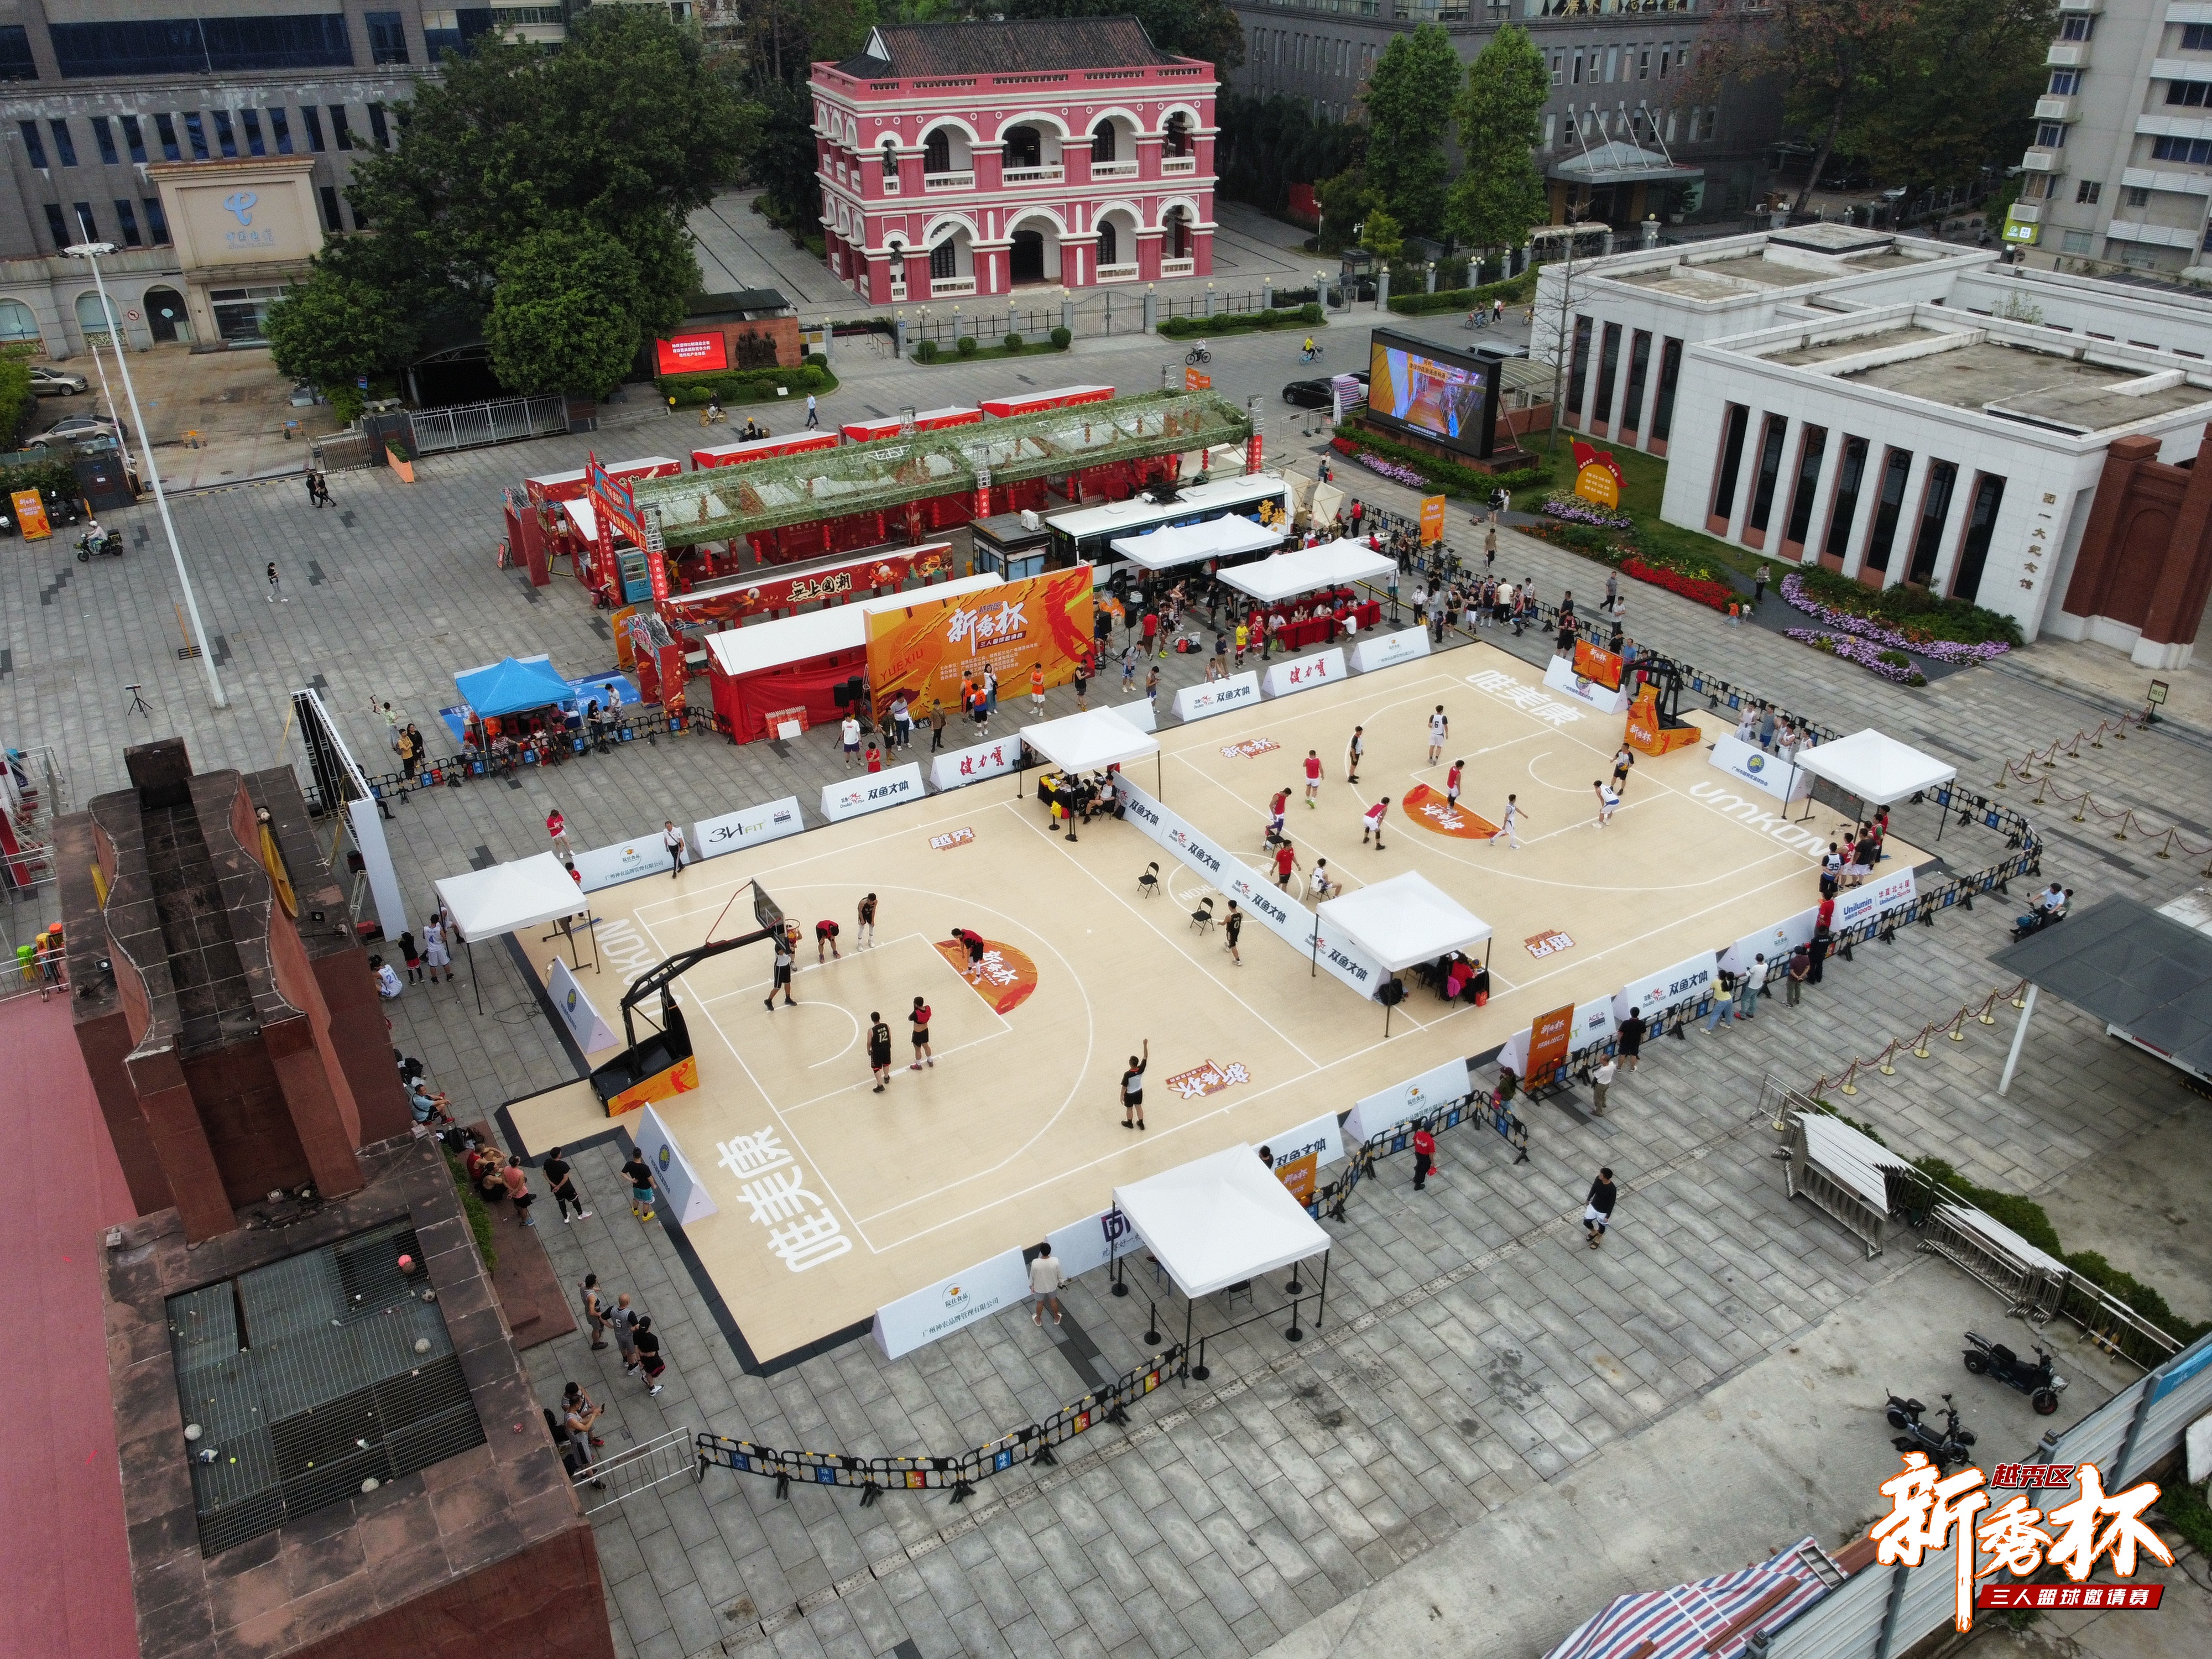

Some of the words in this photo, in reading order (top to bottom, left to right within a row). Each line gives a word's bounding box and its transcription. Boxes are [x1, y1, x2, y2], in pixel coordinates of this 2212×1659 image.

[946, 600, 1029, 657] 新秀杯
[880, 648, 924, 681] YUEXIU
[1216, 686, 1250, 703] 双鱼文体
[1465, 670, 1587, 726] 唯美康
[867, 780, 909, 801] 双鱼文体
[1129, 798, 1160, 826] 双鱼文体
[930, 827, 974, 849] 越秀
[1187, 842, 1220, 873] 双鱼文体
[1828, 863, 1840, 871] 35
[1879, 879, 1910, 898] 华夏北斗星
[1251, 893, 1287, 925] 双鱼文体
[1843, 898, 1872, 915] Unilumin
[1880, 895, 1897, 905] Unilumin
[1328, 948, 1368, 982] 双鱼文体
[385, 972, 397, 983] 21
[1669, 969, 1708, 997] 双鱼文体
[1642, 1000, 1655, 1008] Double
[1589, 1013, 1600, 1022] ACE
[878, 1031, 888, 1043] 12
[1537, 1034, 1564, 1050] 球队出口
[716, 1125, 852, 1272] 唯美康
[945, 1292, 968, 1307] 院仕食品
[922, 1297, 999, 1337] 广州神农品牌管理有限公司
[735, 1453, 744, 1469] 珠光
[998, 1452, 1007, 1469] 珠光
[820, 1468, 830, 1483] 珠光
